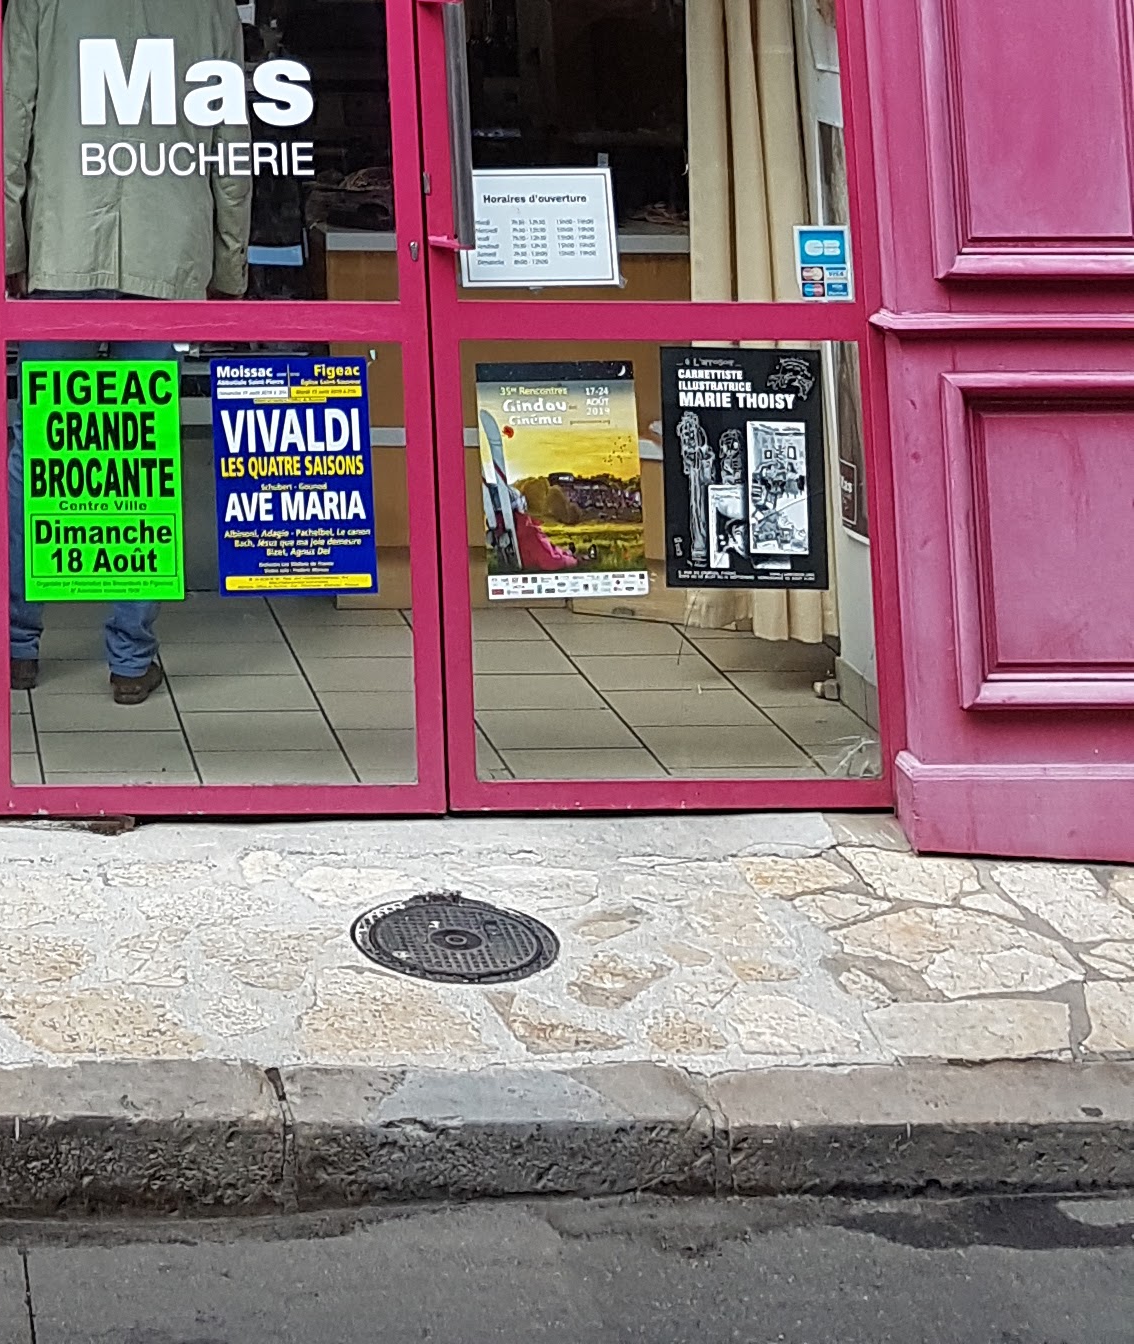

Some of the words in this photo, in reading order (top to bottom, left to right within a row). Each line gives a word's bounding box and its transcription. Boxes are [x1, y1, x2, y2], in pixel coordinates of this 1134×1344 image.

[79, 38, 314, 127] Mas
[81, 142, 315, 176] BOUCHERIE
[483, 195, 526, 203] Horaires
[528, 194, 587, 203] d'ouverture
[216, 365, 273, 378] Moissac
[314, 364, 361, 379] Figeac
[678, 369, 743, 380] CARNETTISTE
[28, 369, 173, 406] FIGEAC
[519, 386, 568, 395] Rencontres
[585, 386, 609, 396] 17-24
[678, 380, 752, 392] ILLUSTRATRICE
[503, 397, 568, 412] Gindou
[679, 392, 732, 408] MARIE
[736, 393, 796, 409] THOISY
[509, 413, 563, 425] Cinéma
[586, 407, 611, 416] 2019
[46, 410, 156, 452] GRANDE
[220, 408, 361, 453] VIVALDI
[220, 457, 245, 478] LES
[248, 456, 302, 480] QUATRE
[304, 454, 365, 476] SAISONS
[30, 457, 176, 498] BROCANTE
[59, 500, 109, 511] Centre
[113, 500, 148, 511] Ville
[224, 492, 274, 522] AVE
[280, 490, 367, 521] MARIA
[35, 518, 173, 544] Dimanche
[51, 547, 83, 573] 18
[92, 547, 158, 573] Août
